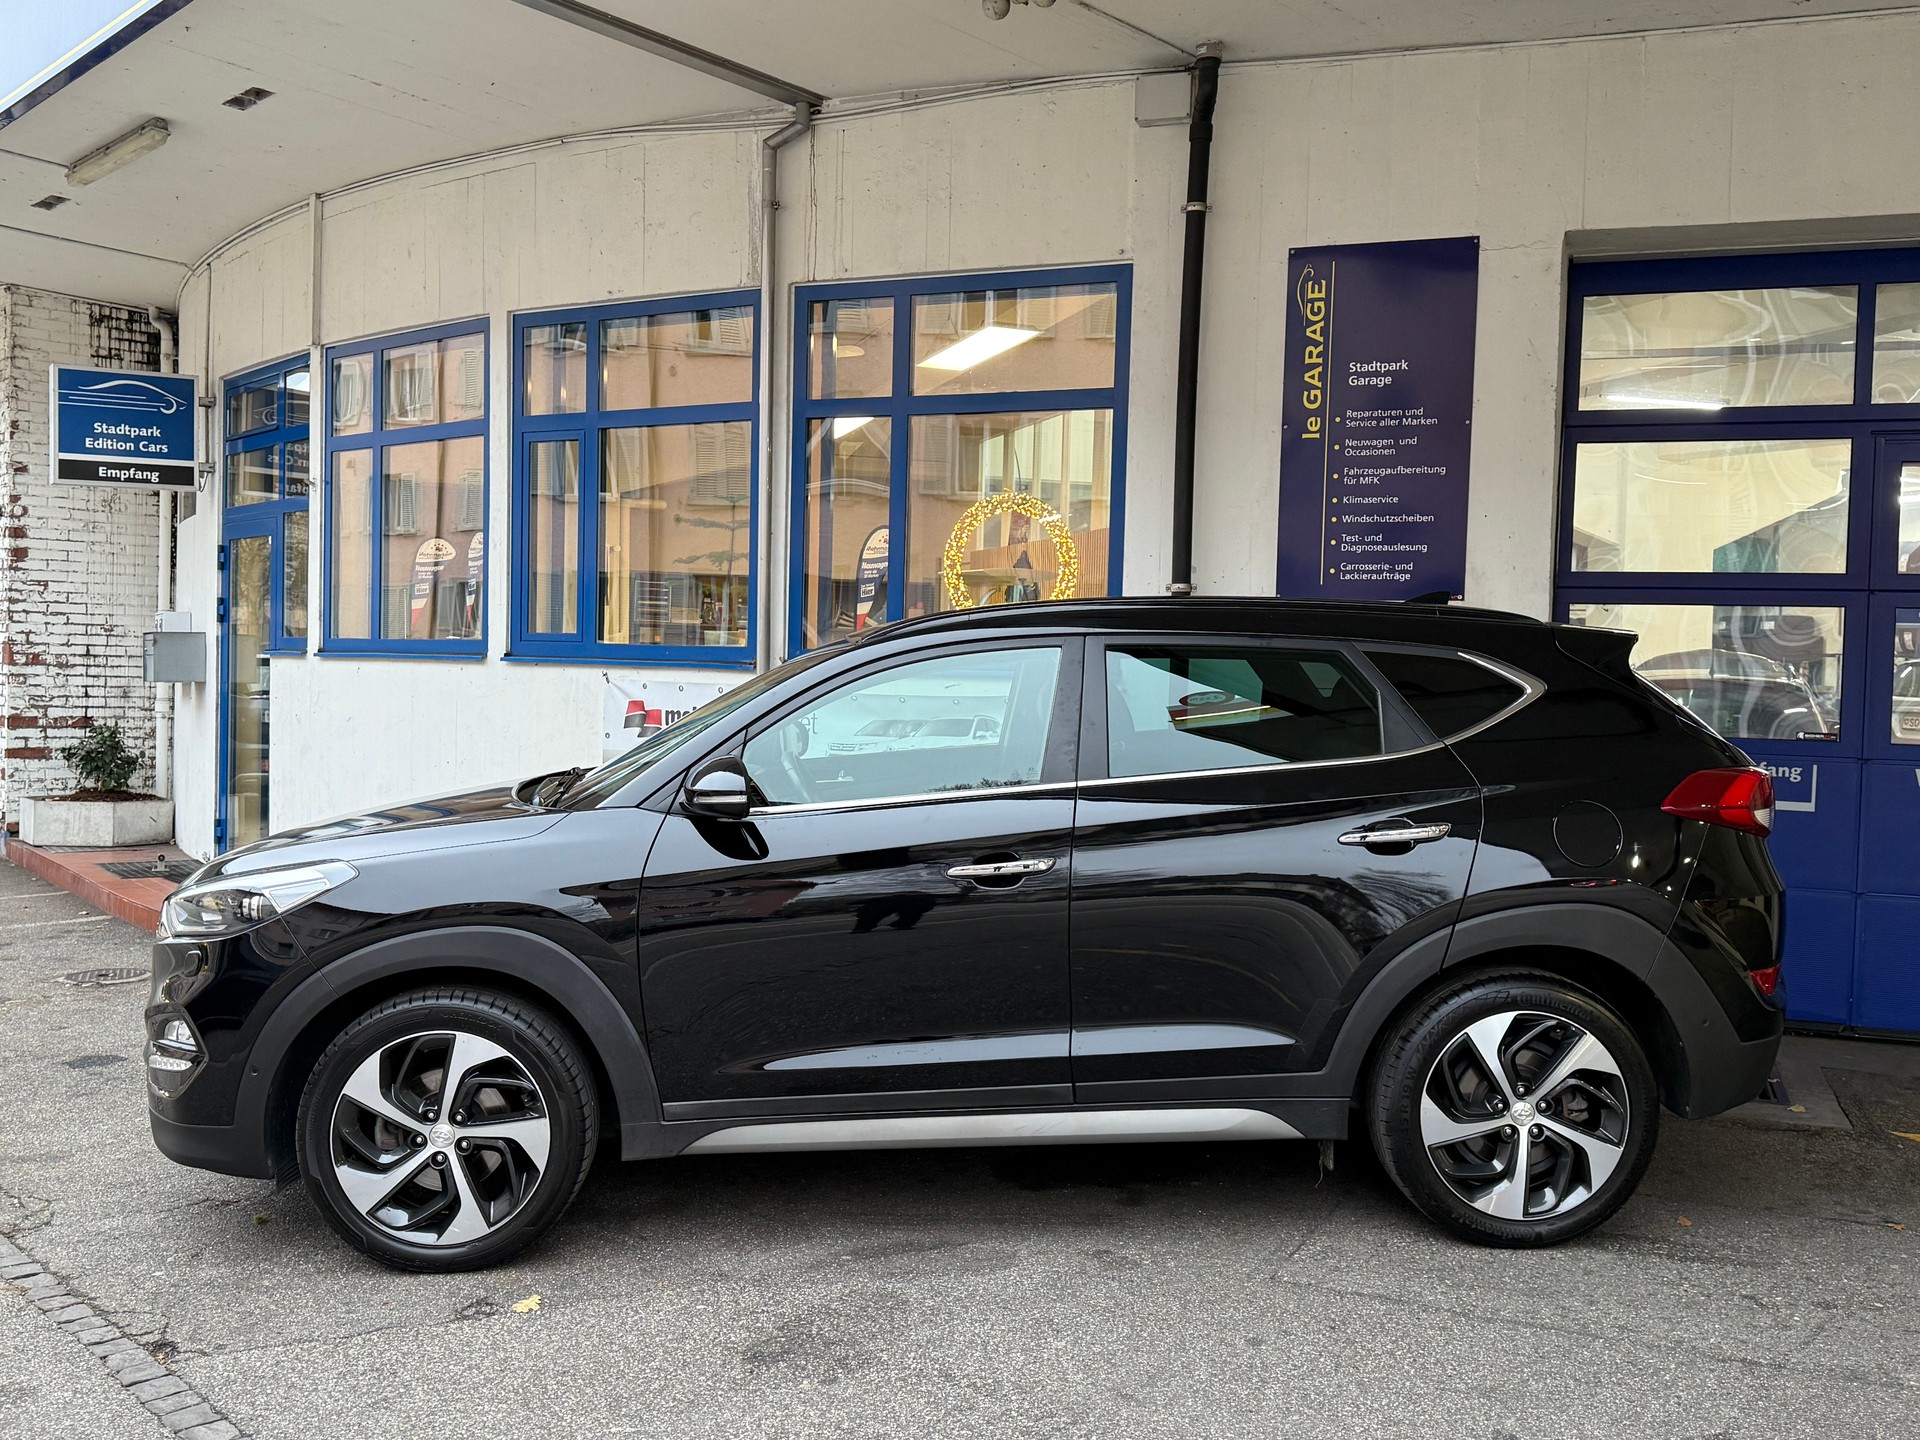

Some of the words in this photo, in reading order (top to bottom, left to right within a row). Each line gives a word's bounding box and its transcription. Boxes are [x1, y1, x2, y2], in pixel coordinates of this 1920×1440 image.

[1303, 279, 1327, 411] GARAGE
[1349, 360, 1408, 373] Stadtpark
[1349, 375, 1392, 387] Garage
[1346, 410, 1402, 418] Reparaturen
[1405, 407, 1424, 415] und
[1346, 418, 1377, 427] Service
[1380, 418, 1400, 426] aller
[1402, 416, 1438, 426] Marken
[94, 422, 161, 438] Stadtpark
[1302, 417, 1320, 438] le
[85, 437, 134, 451] Edition
[139, 441, 168, 453] Cars
[1345, 439, 1394, 447] Neuwagen
[1399, 437, 1417, 446] und
[1345, 447, 1396, 456] Occasionen
[98, 467, 160, 483] Empfang
[1344, 465, 1446, 476] Fahrzeugaufbereitung
[1344, 476, 1357, 485] für
[1360, 476, 1381, 485] MFK
[1343, 495, 1399, 504] Klimaservice
[1342, 513, 1434, 523] Windschutzscheiben
[1342, 533, 1363, 542] Test-
[1365, 533, 1383, 541] und
[1341, 542, 1428, 553] Diagnoseauslesung
[1340, 562, 1393, 571] Carrosserie-
[1396, 561, 1414, 570] und
[1340, 571, 1411, 582] Lackieraufträge
